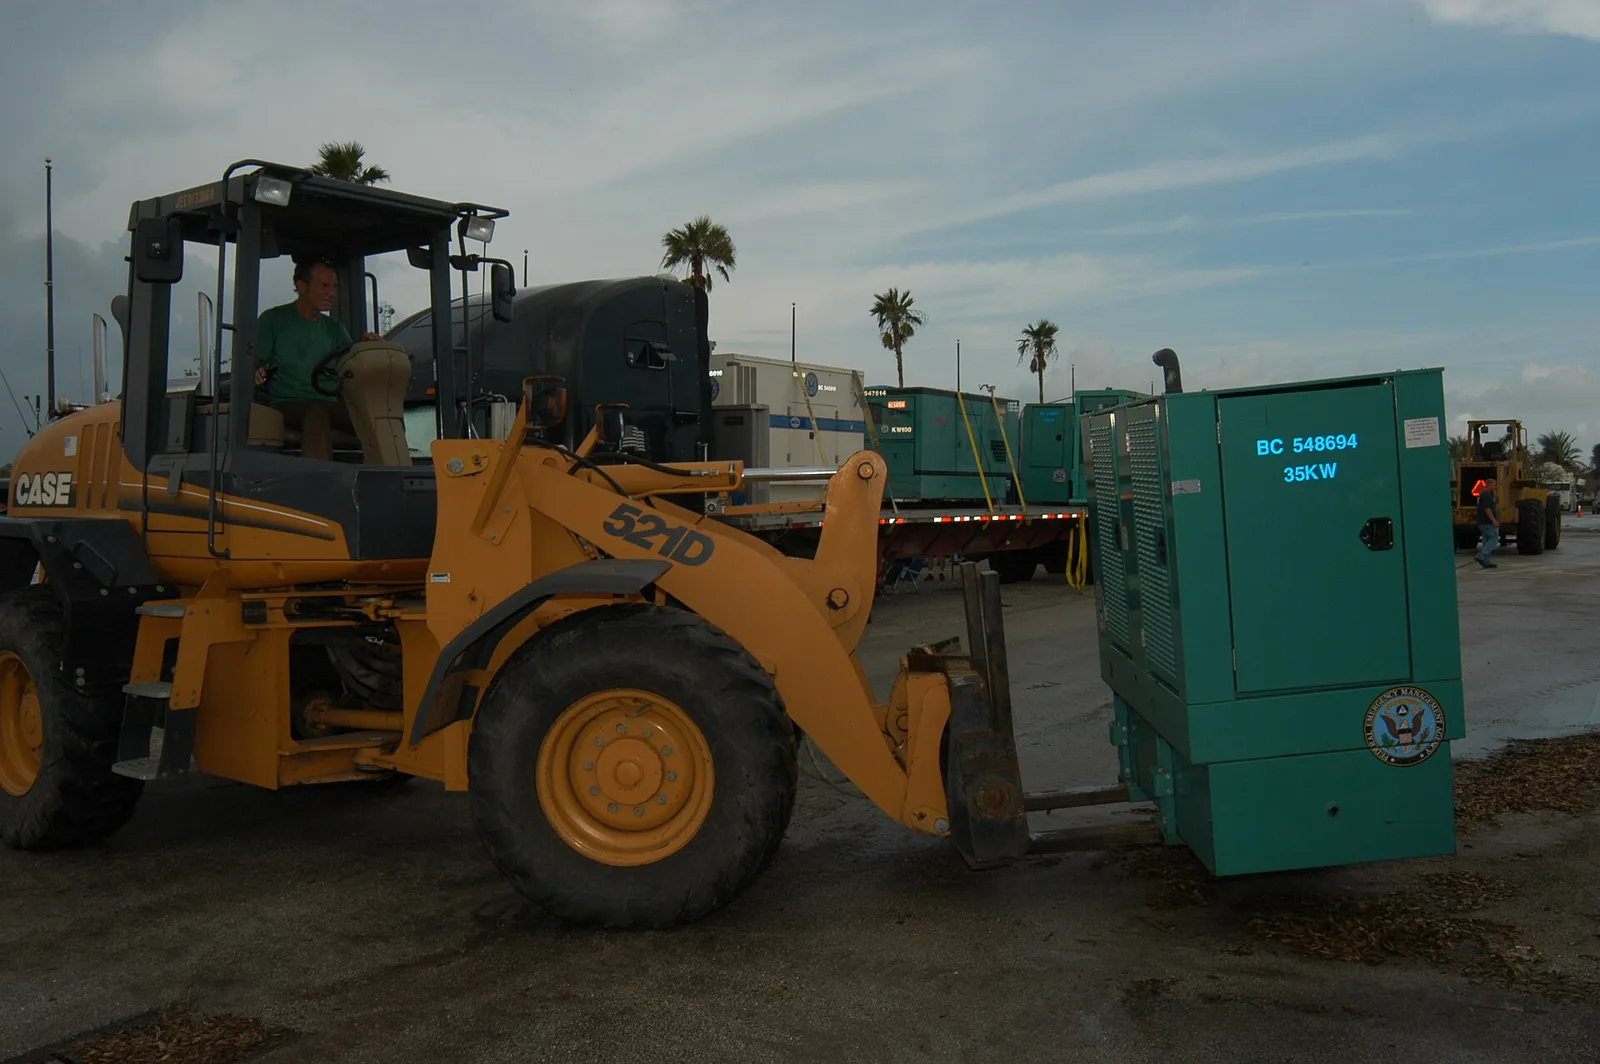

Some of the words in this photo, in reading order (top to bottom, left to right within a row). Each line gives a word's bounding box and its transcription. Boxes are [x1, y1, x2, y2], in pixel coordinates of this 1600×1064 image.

[1256, 438, 1285, 456] BC
[1292, 432, 1358, 454] 548694
[15, 471, 73, 506] CASE
[1283, 461, 1338, 483] 35KW
[603, 503, 715, 566] 521D
[1366, 689, 1398, 727] EMERGENCY
[1401, 688, 1443, 724] MANAGEMENT
